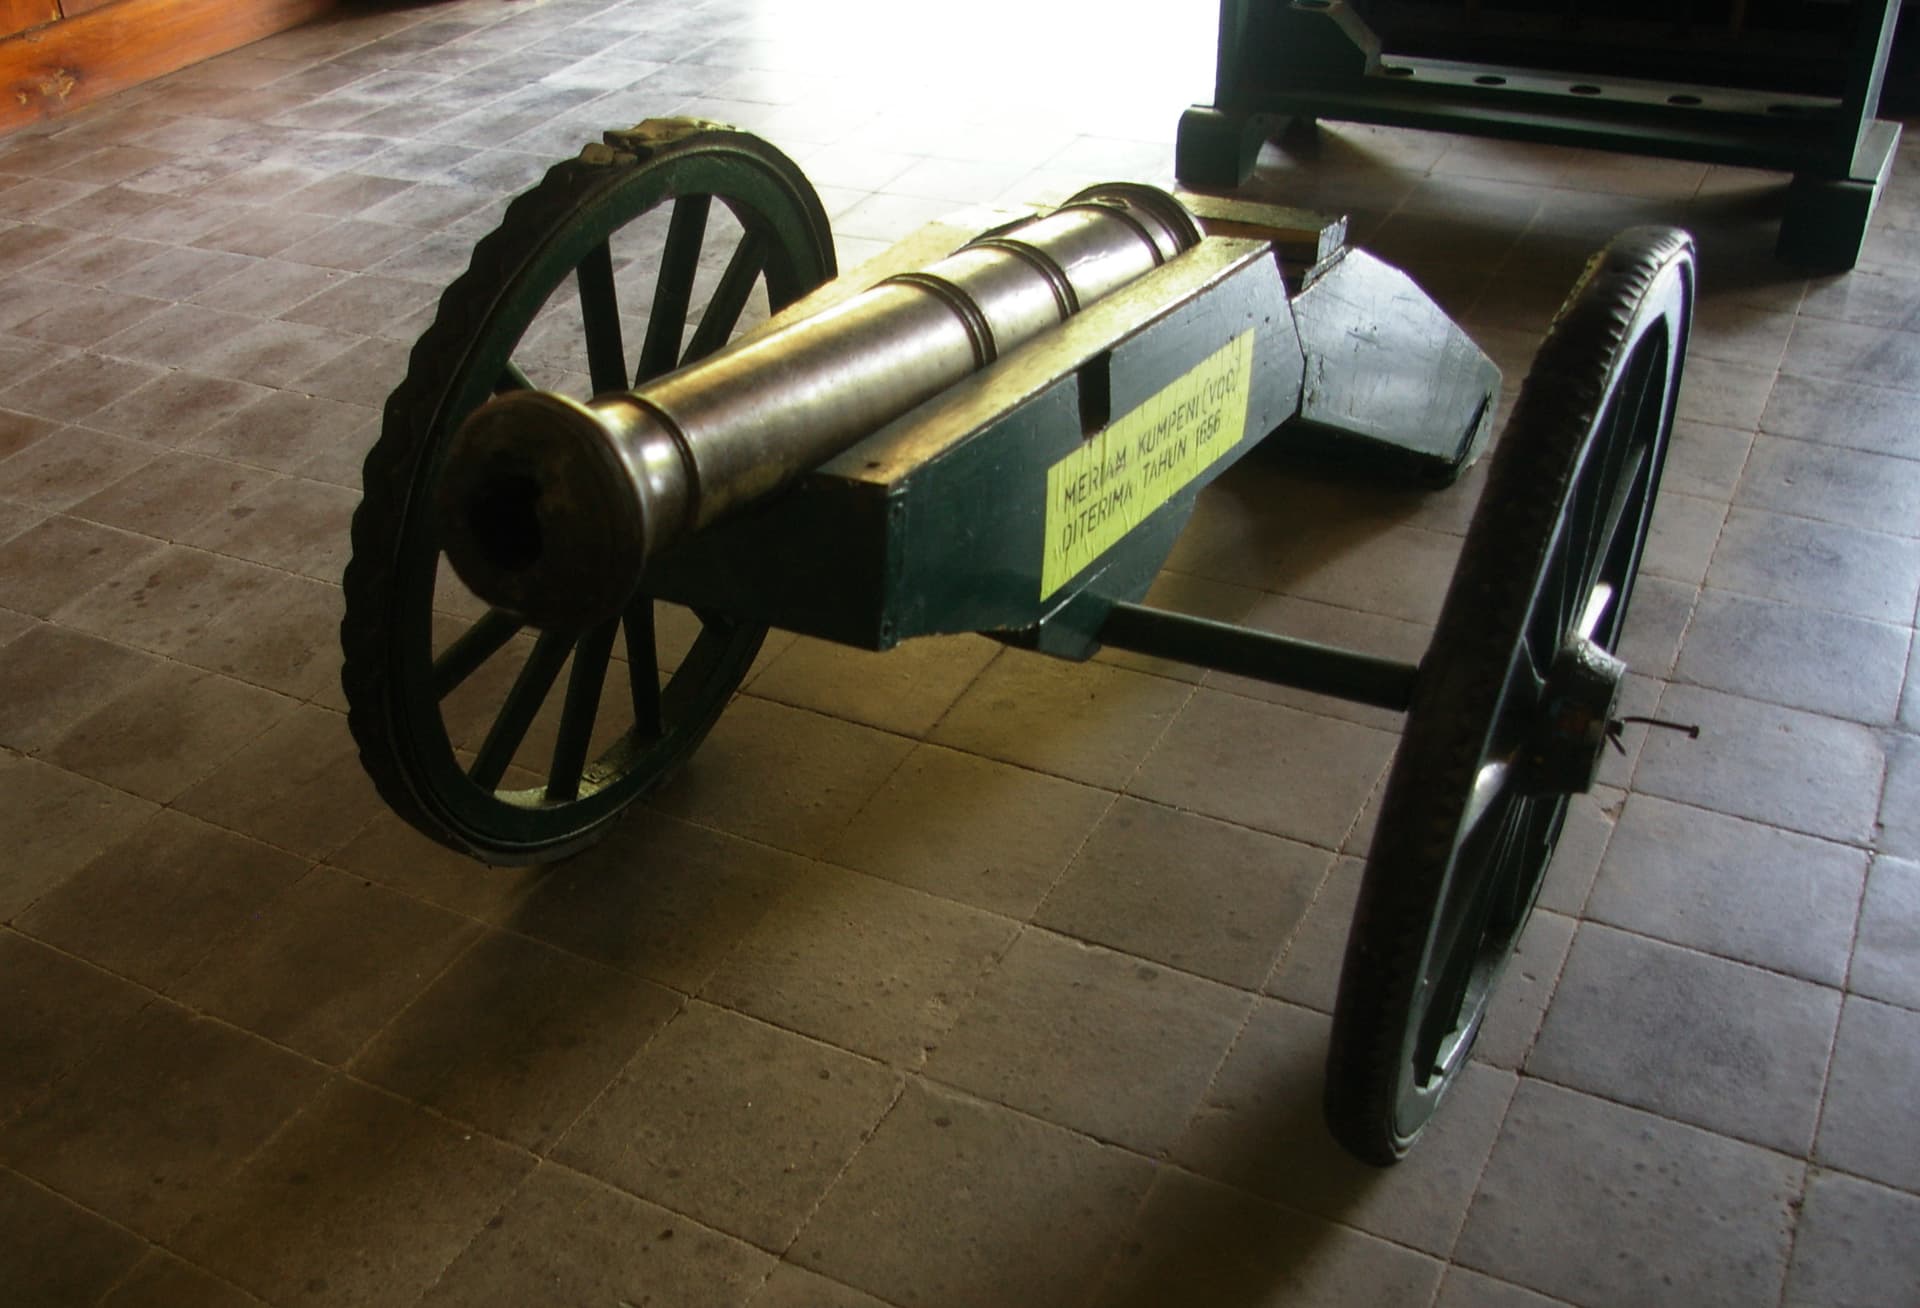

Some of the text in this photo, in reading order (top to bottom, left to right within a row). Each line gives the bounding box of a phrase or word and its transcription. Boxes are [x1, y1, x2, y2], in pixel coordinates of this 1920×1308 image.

[1062, 408, 1221, 552] DITERIMA TAHUN 1656
[1064, 446, 1126, 513] MERIAM
[1137, 395, 1199, 460] KUMPENI
